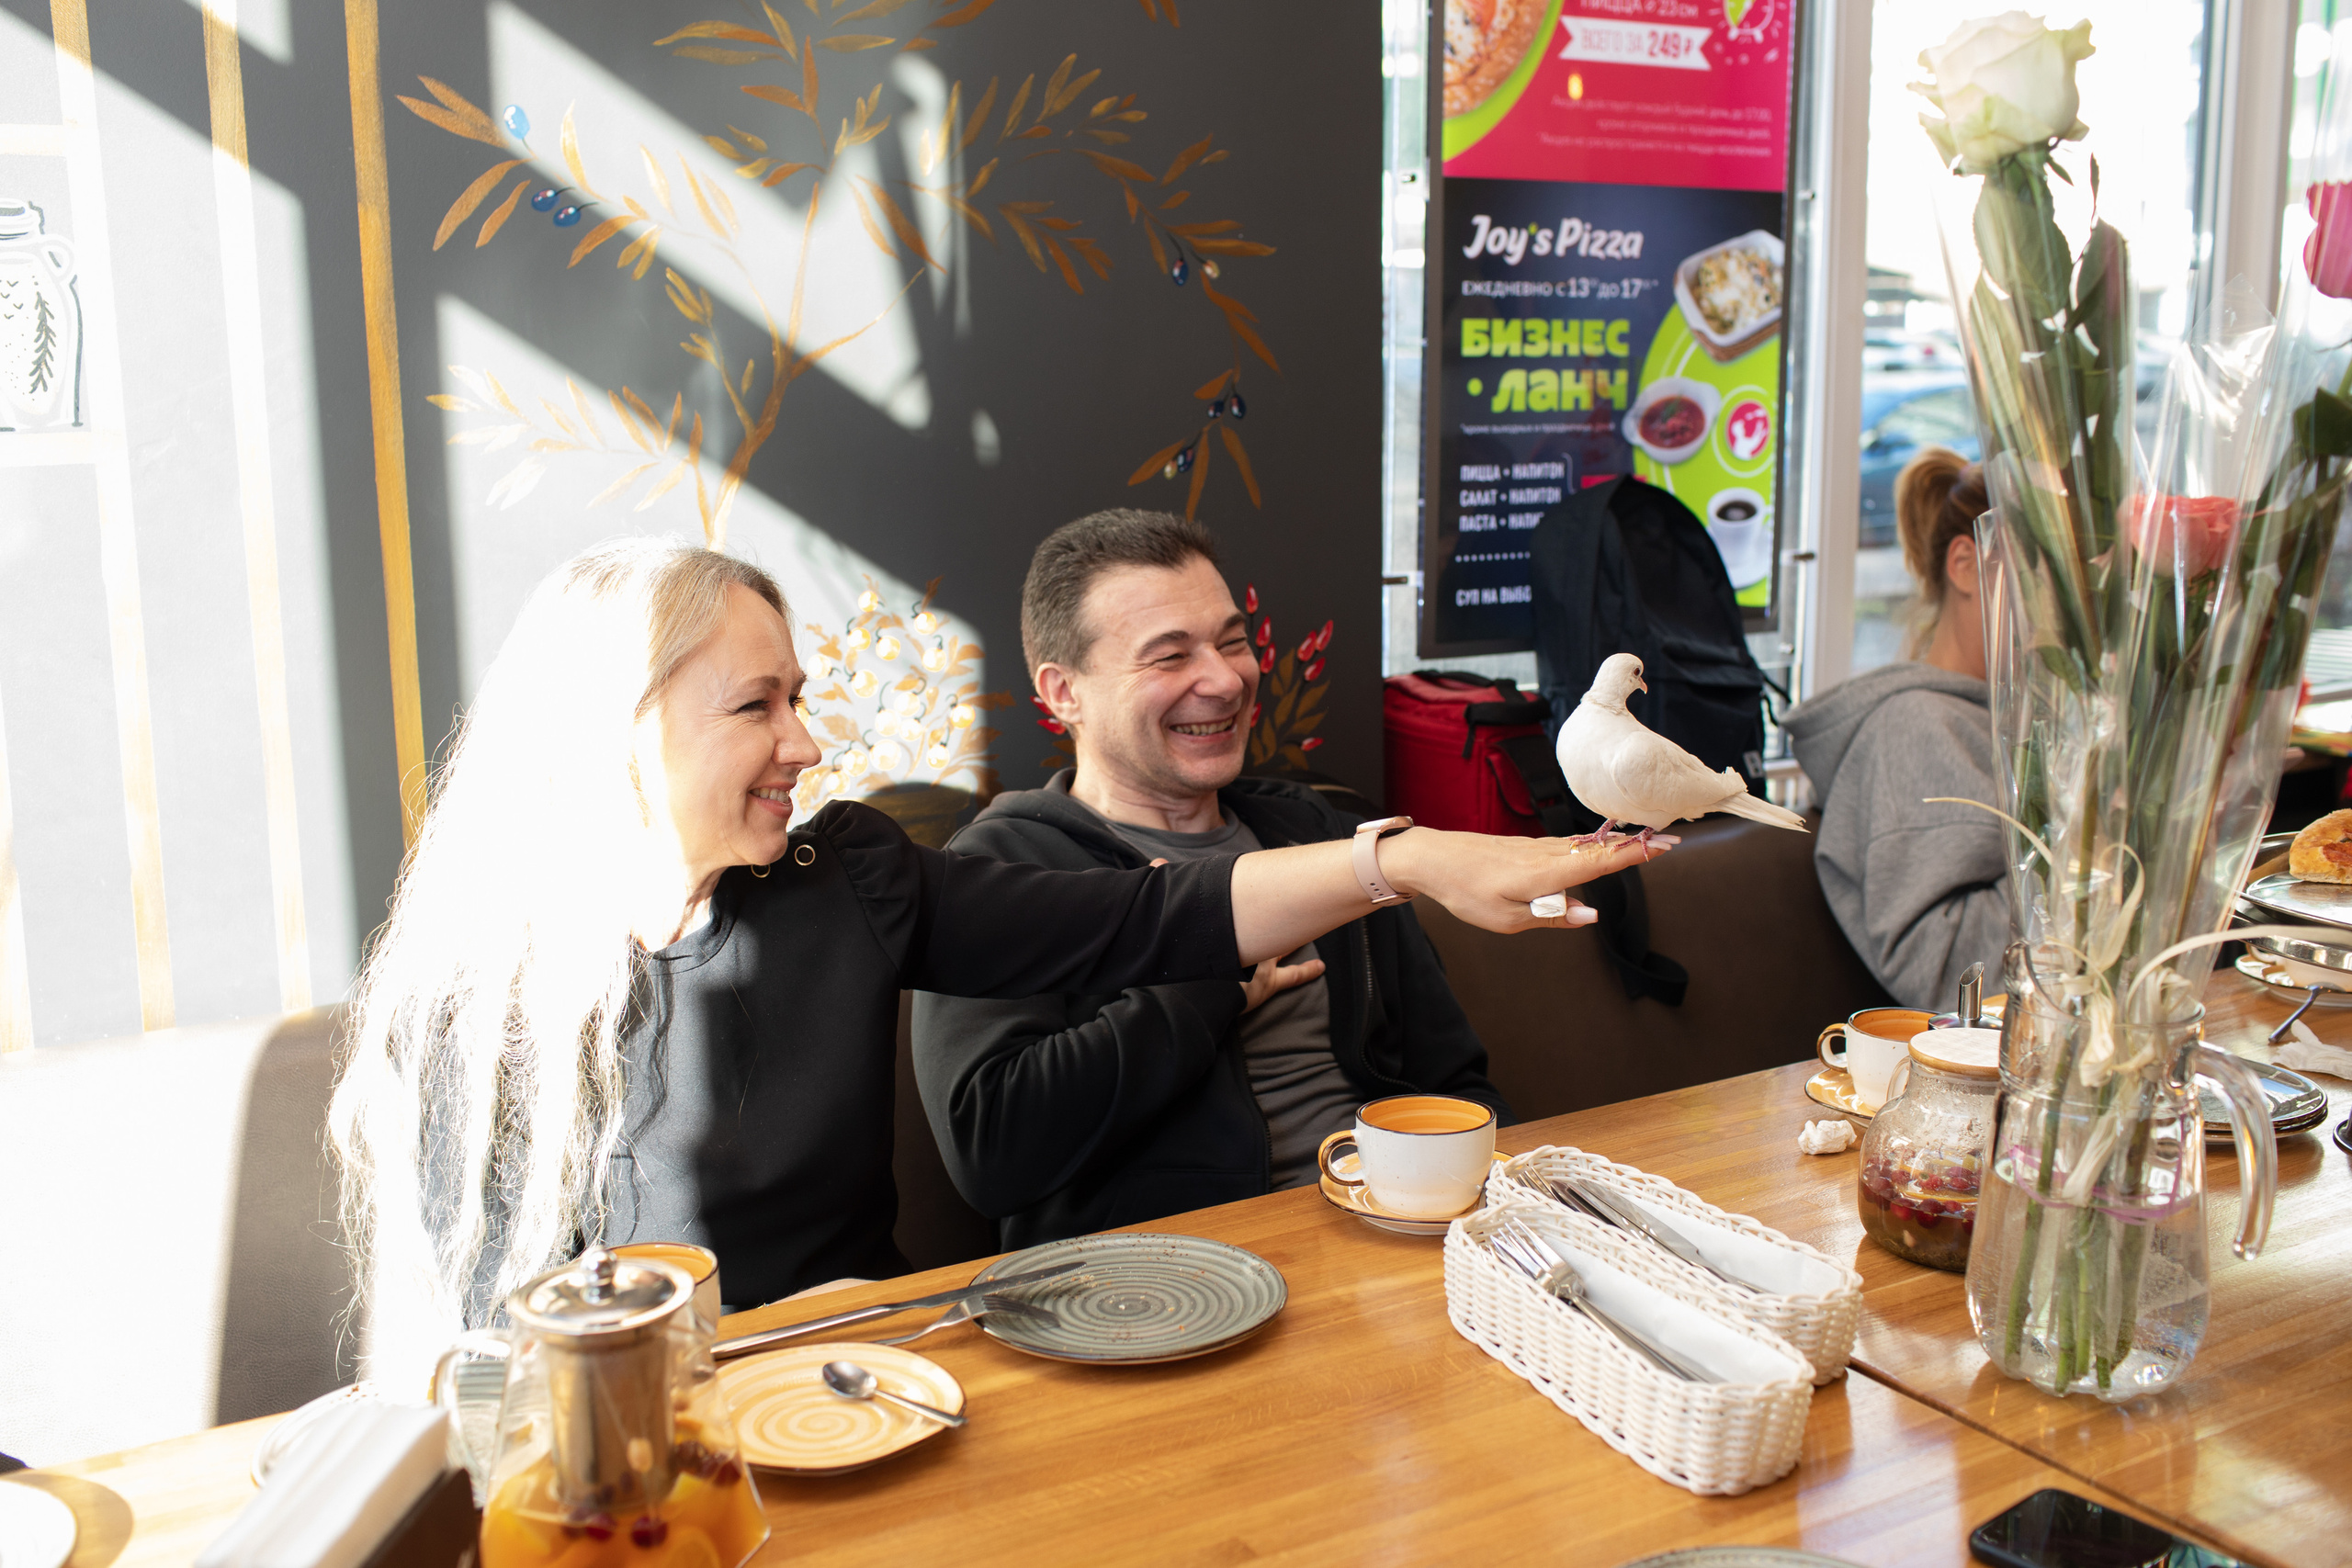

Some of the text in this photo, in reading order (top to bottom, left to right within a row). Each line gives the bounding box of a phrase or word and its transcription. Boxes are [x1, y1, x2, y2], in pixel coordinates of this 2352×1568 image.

[1647, 29, 1680, 59] 249
[1463, 214, 1645, 265] Joy's Pizza
[1462, 280, 1554, 299] ЕЖЕДНЕВНО
[1597, 283, 1620, 299] до
[1461, 318, 1630, 357] БИЗНЕС
[1460, 465, 1501, 482] ПИЦЦА
[1459, 489, 1498, 507] САЛАТ
[1458, 512, 1544, 532] ПАСТА НАПИ
[1455, 585, 1532, 607] СУП НА ВЫБО
